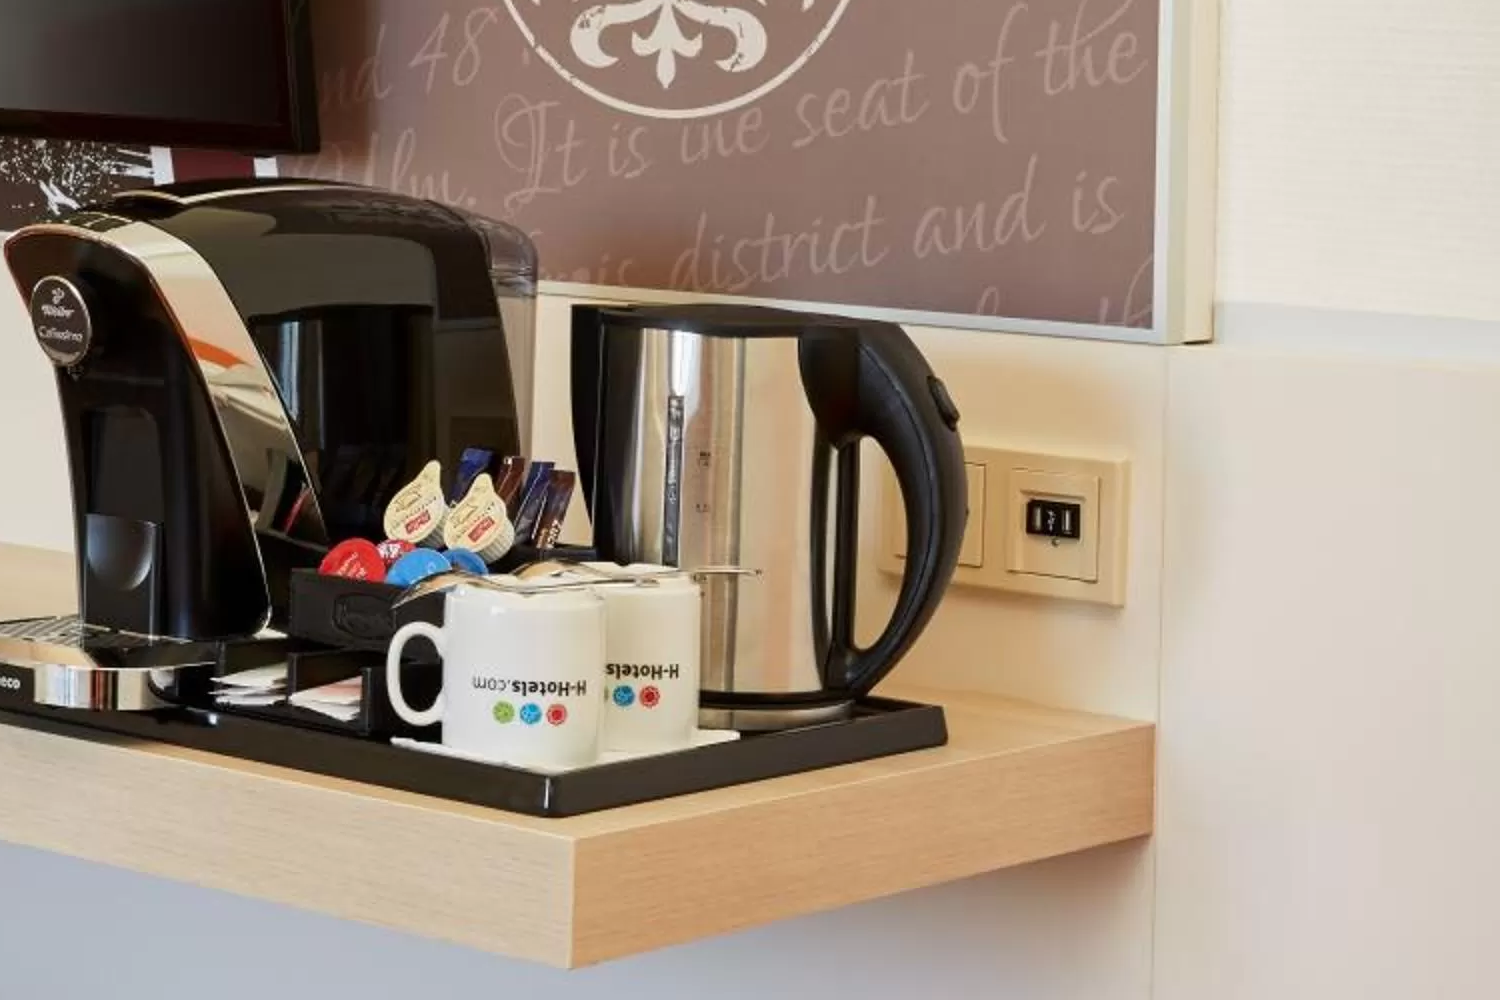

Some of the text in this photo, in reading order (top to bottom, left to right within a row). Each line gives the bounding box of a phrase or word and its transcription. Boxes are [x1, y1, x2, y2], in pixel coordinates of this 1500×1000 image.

[322, 22, 394, 106] nd
[408, 6, 498, 95] 48
[494, 93, 588, 221] It
[607, 122, 652, 178] is
[792, 49, 929, 147] seat
[952, 4, 1028, 143] of
[667, 153, 1125, 292] district and is
[472, 675, 588, 697] H-Hotels.com
